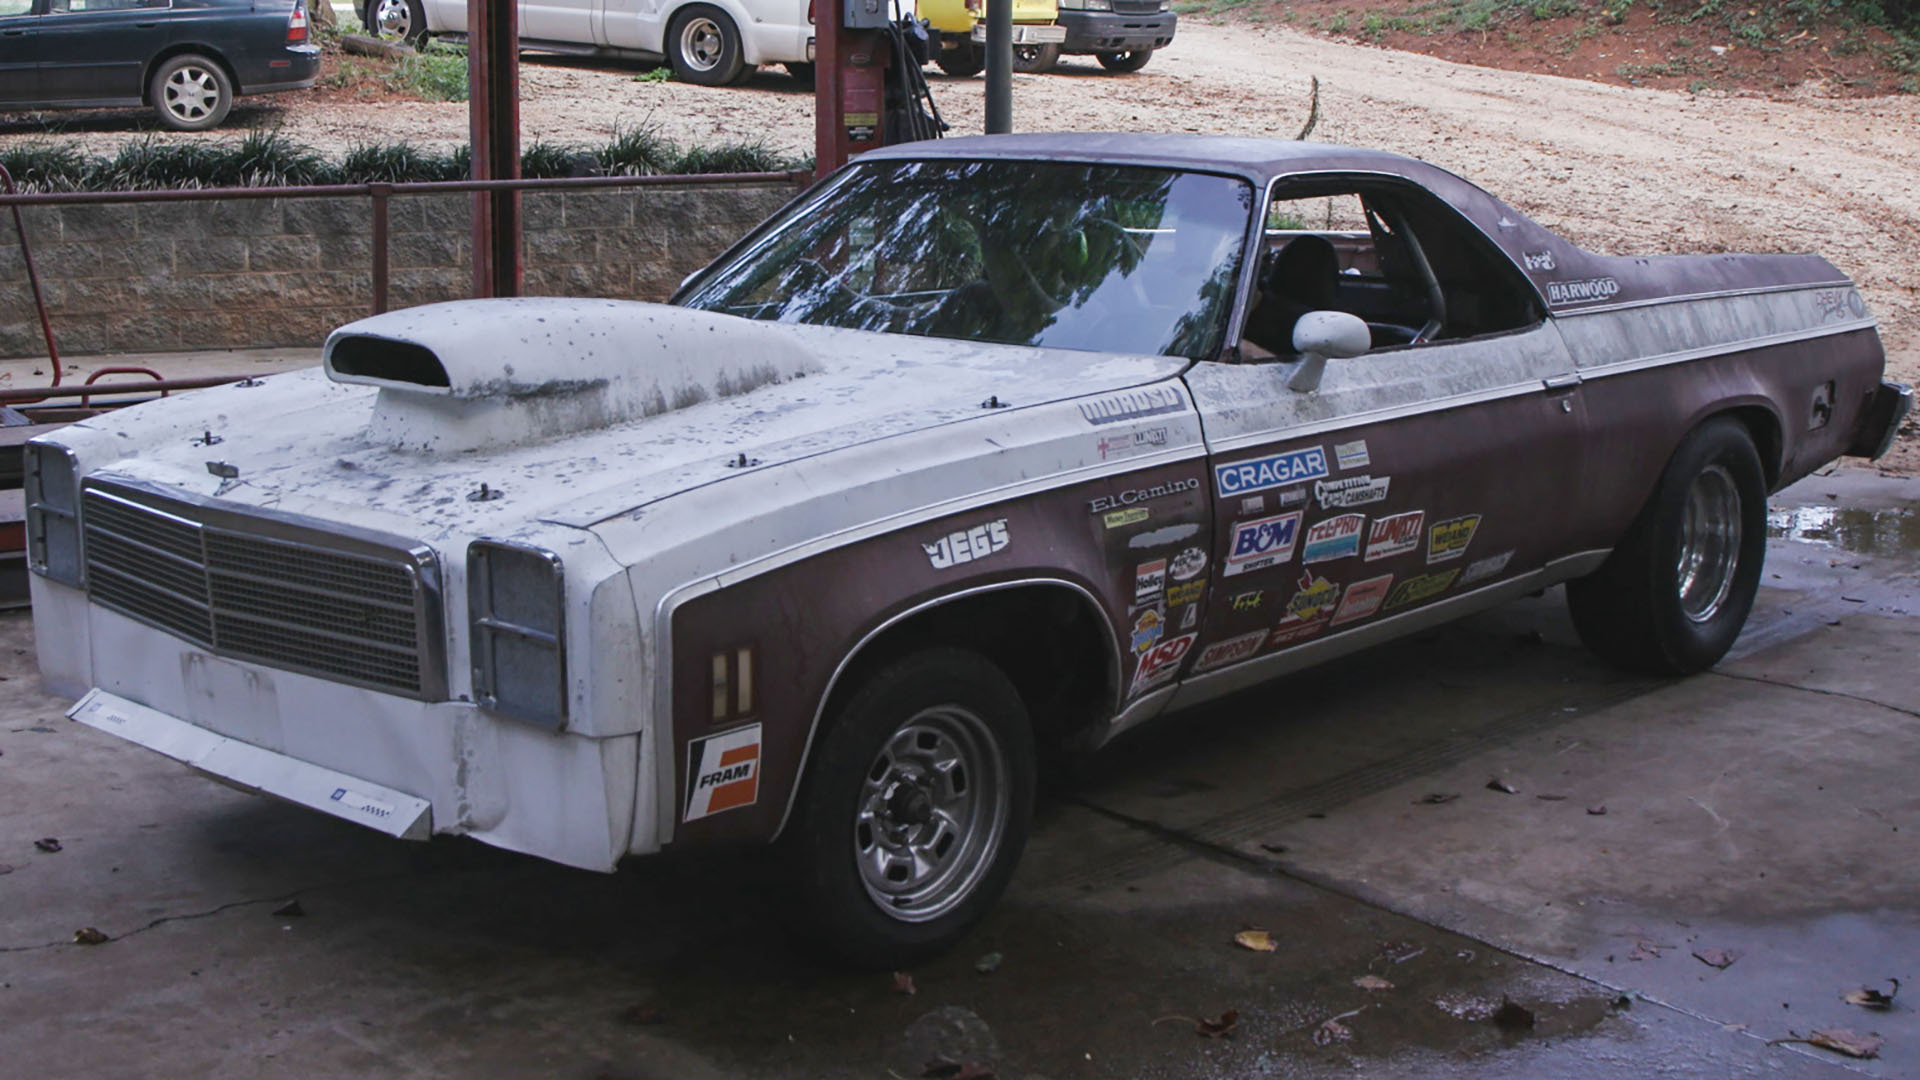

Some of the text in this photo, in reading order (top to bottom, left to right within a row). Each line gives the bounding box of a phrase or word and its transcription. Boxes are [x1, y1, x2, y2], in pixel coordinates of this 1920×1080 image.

[1550, 281, 1619, 302] HARWOOD
[1221, 452, 1324, 491] CRAGAR
[1234, 518, 1297, 556] B&M
[1309, 516, 1359, 542] FEL-PRO
[1369, 514, 1423, 545] LUNATI
[1136, 574, 1163, 591] Holley
[1135, 635, 1193, 681] MSD
[699, 763, 751, 789] FRAM
